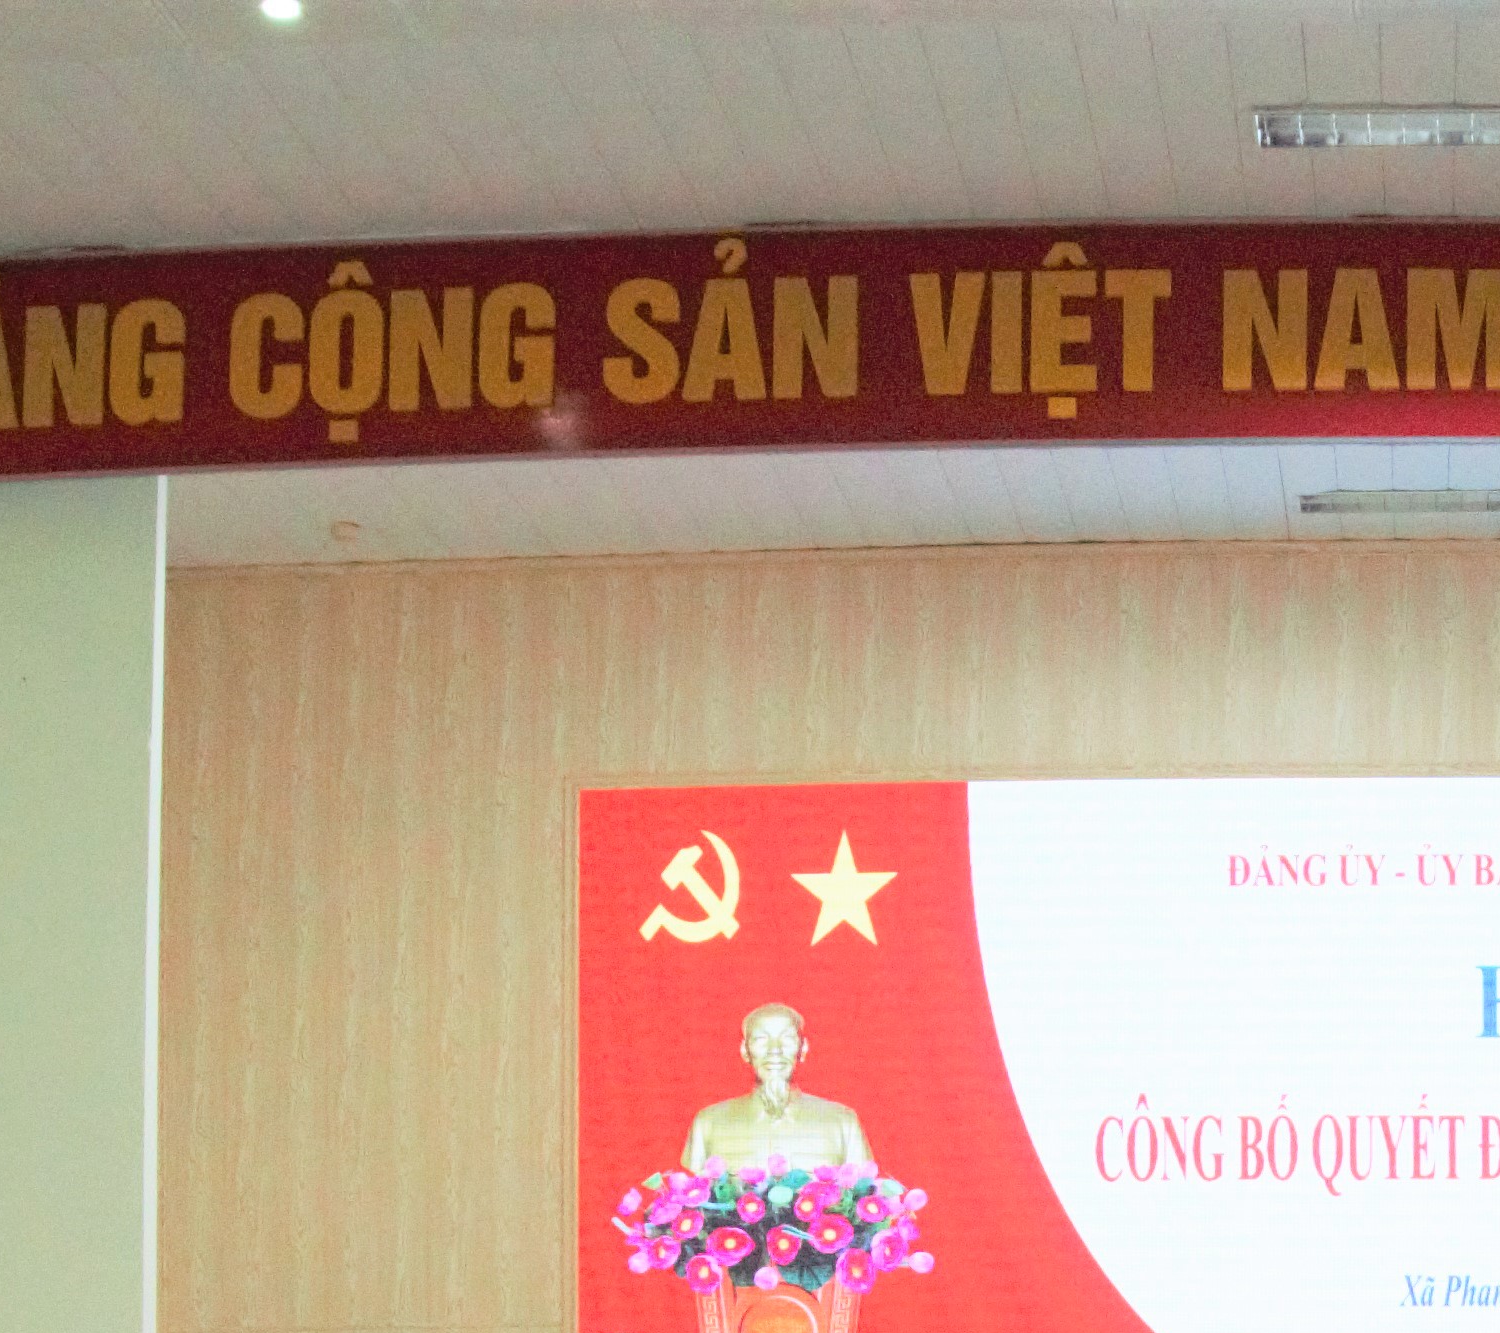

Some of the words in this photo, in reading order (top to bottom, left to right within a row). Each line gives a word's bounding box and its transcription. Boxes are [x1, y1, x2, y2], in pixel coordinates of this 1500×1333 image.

[229, 261, 557, 442] CỘNG
[602, 239, 859, 404] SẢN
[910, 242, 1171, 419] VIỆT
[1229, 845, 1326, 886] ĐẢNG
[1340, 845, 1385, 886] ỦY
[1417, 845, 1463, 886] ỦY
[1095, 1093, 1223, 1182] CÔNG
[1240, 1095, 1298, 1181] BỐ
[1312, 1094, 1465, 1197] QUYẾT
[1400, 1274, 1435, 1307] Xã
